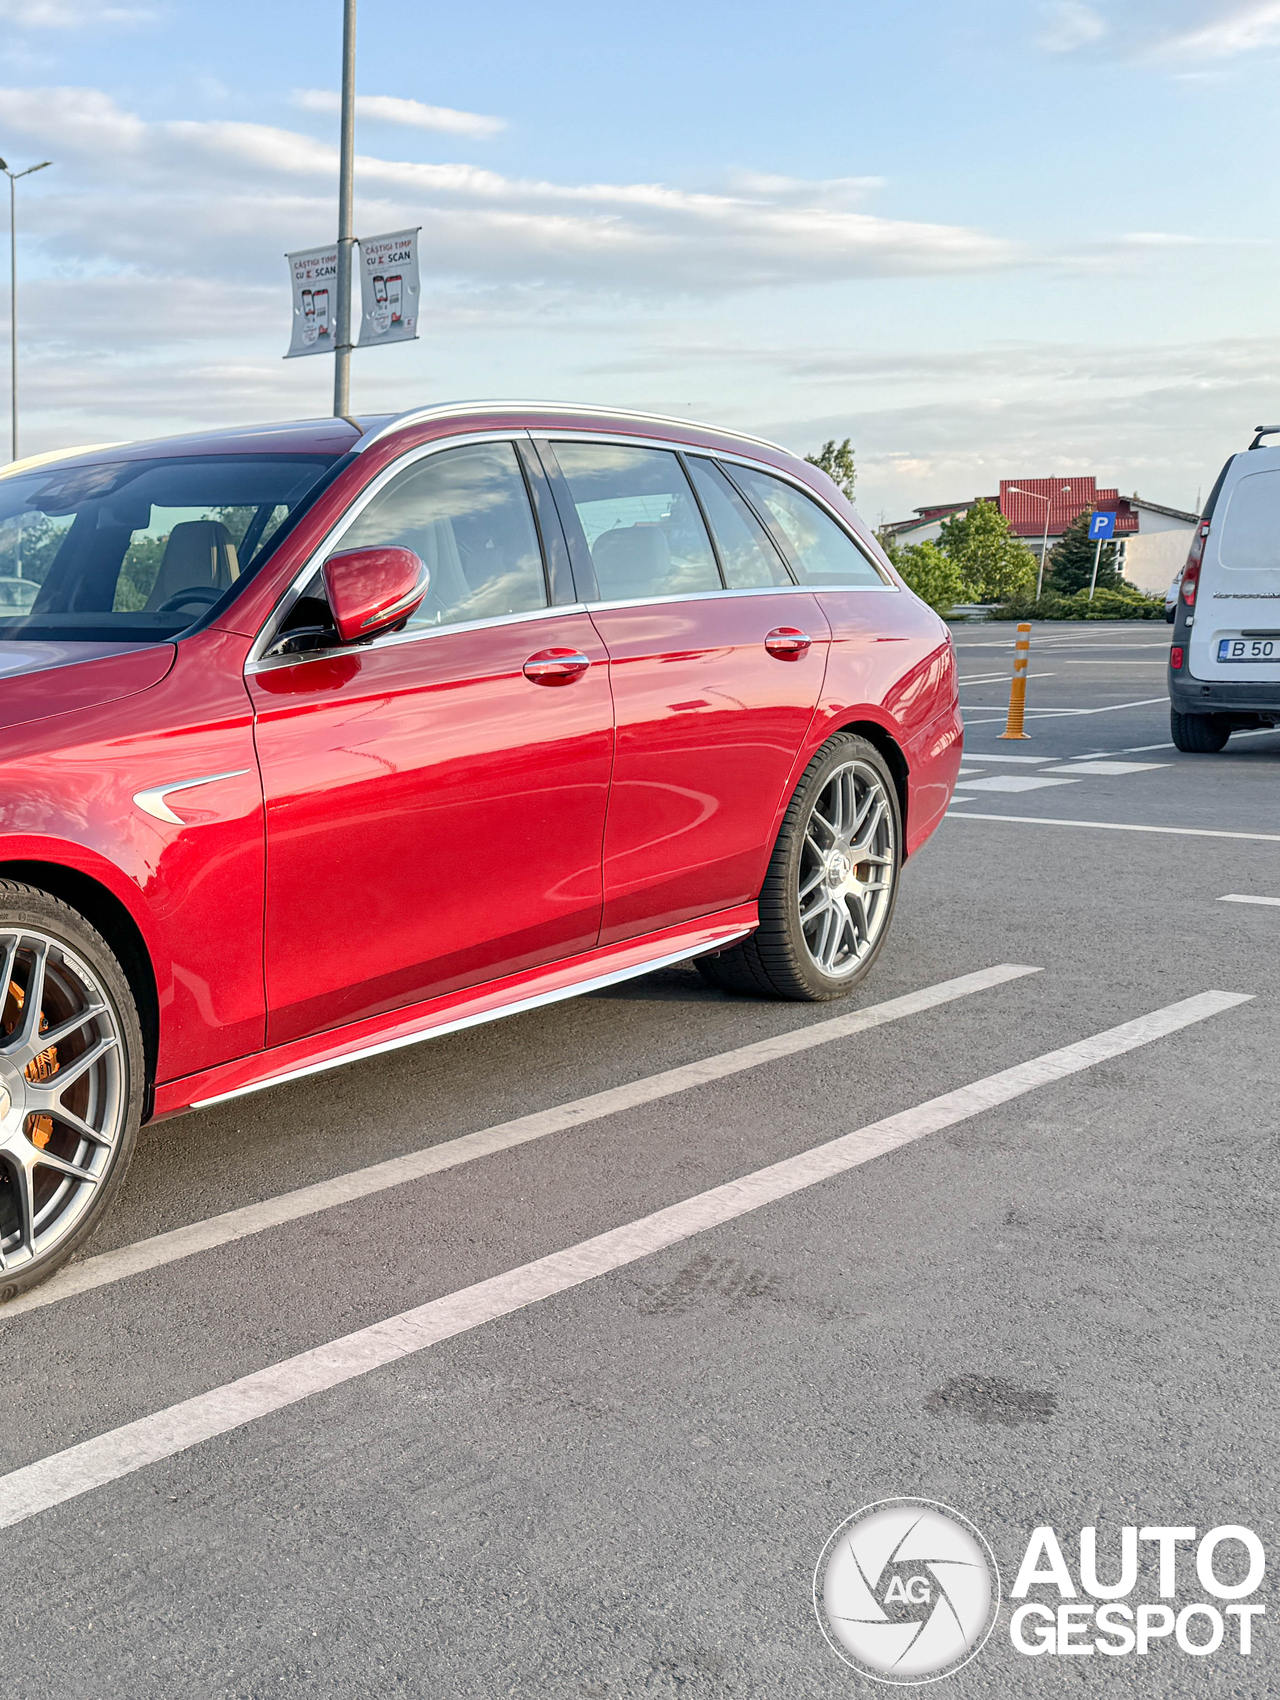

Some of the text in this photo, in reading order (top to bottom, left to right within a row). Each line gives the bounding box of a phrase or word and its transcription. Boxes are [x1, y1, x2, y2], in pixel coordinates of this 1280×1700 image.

[395, 239, 412, 249] TIMP
[366, 257, 376, 266] CU
[388, 251, 410, 263] SCAN
[296, 272, 304, 280] CU
[315, 266, 336, 278] SCAN
[1094, 516, 1109, 533] P
[1232, 641, 1274, 657] B 50
